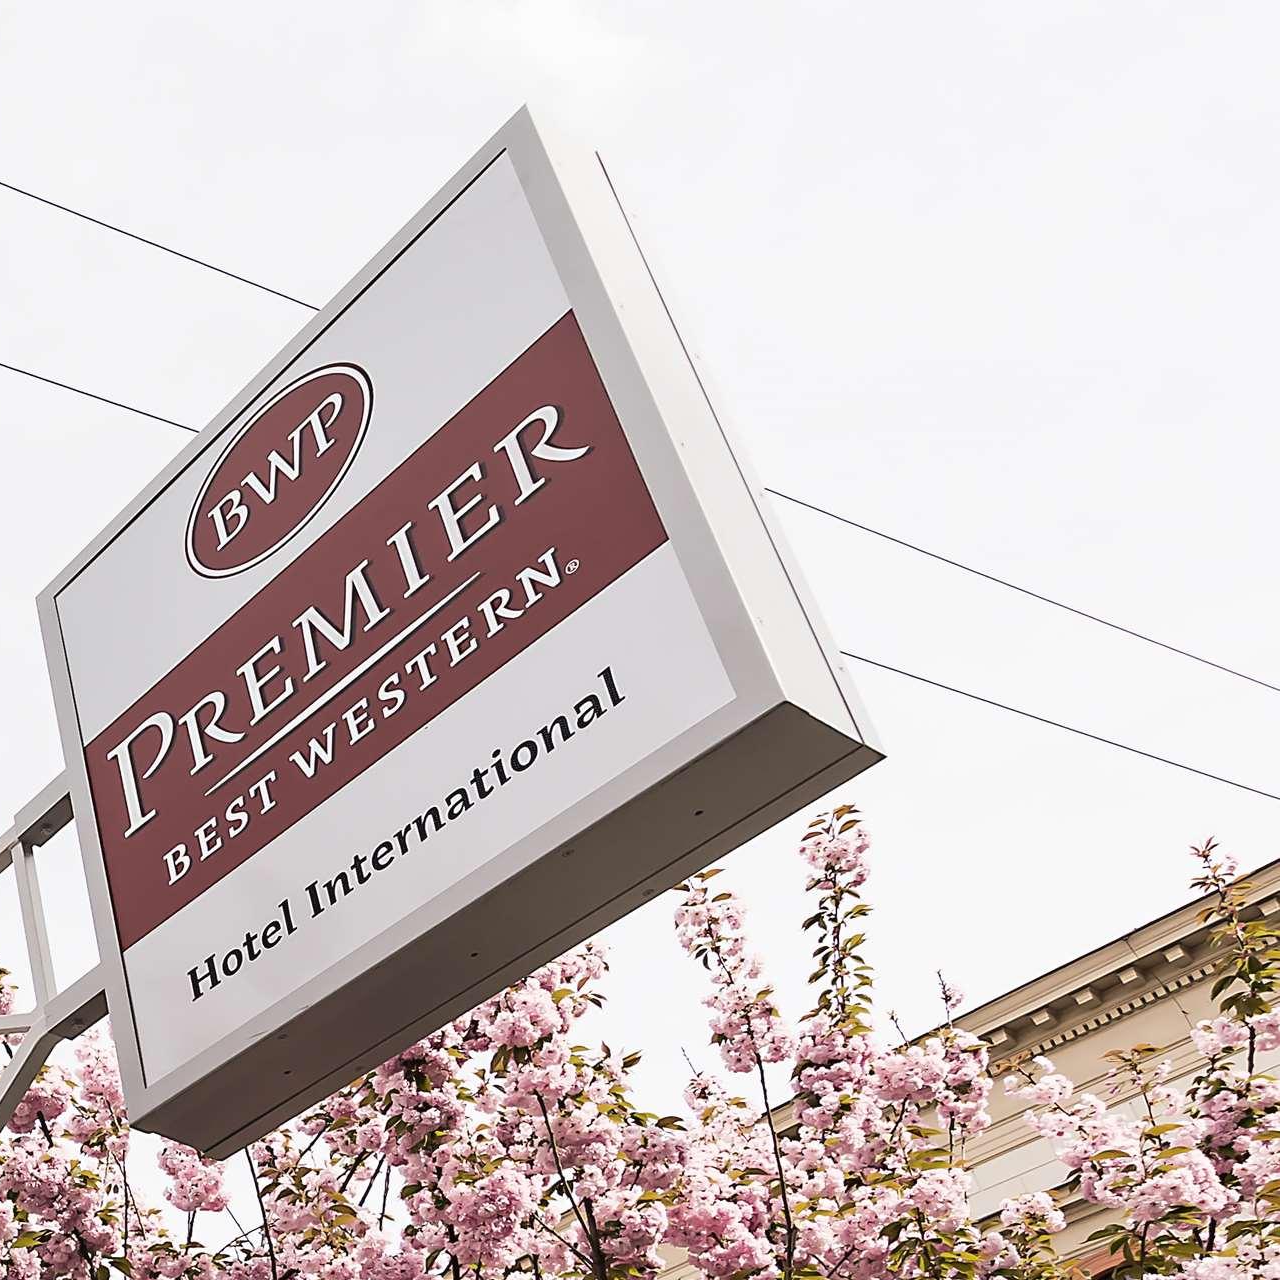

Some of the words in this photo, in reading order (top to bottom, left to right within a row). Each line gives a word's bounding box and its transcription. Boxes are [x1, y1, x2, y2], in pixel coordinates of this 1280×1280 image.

[207, 391, 344, 552] BWP
[106, 404, 592, 838] PREMIER
[162, 770, 278, 886] BEST
[186, 898, 299, 1002] Hotel
[304, 666, 627, 919] International
